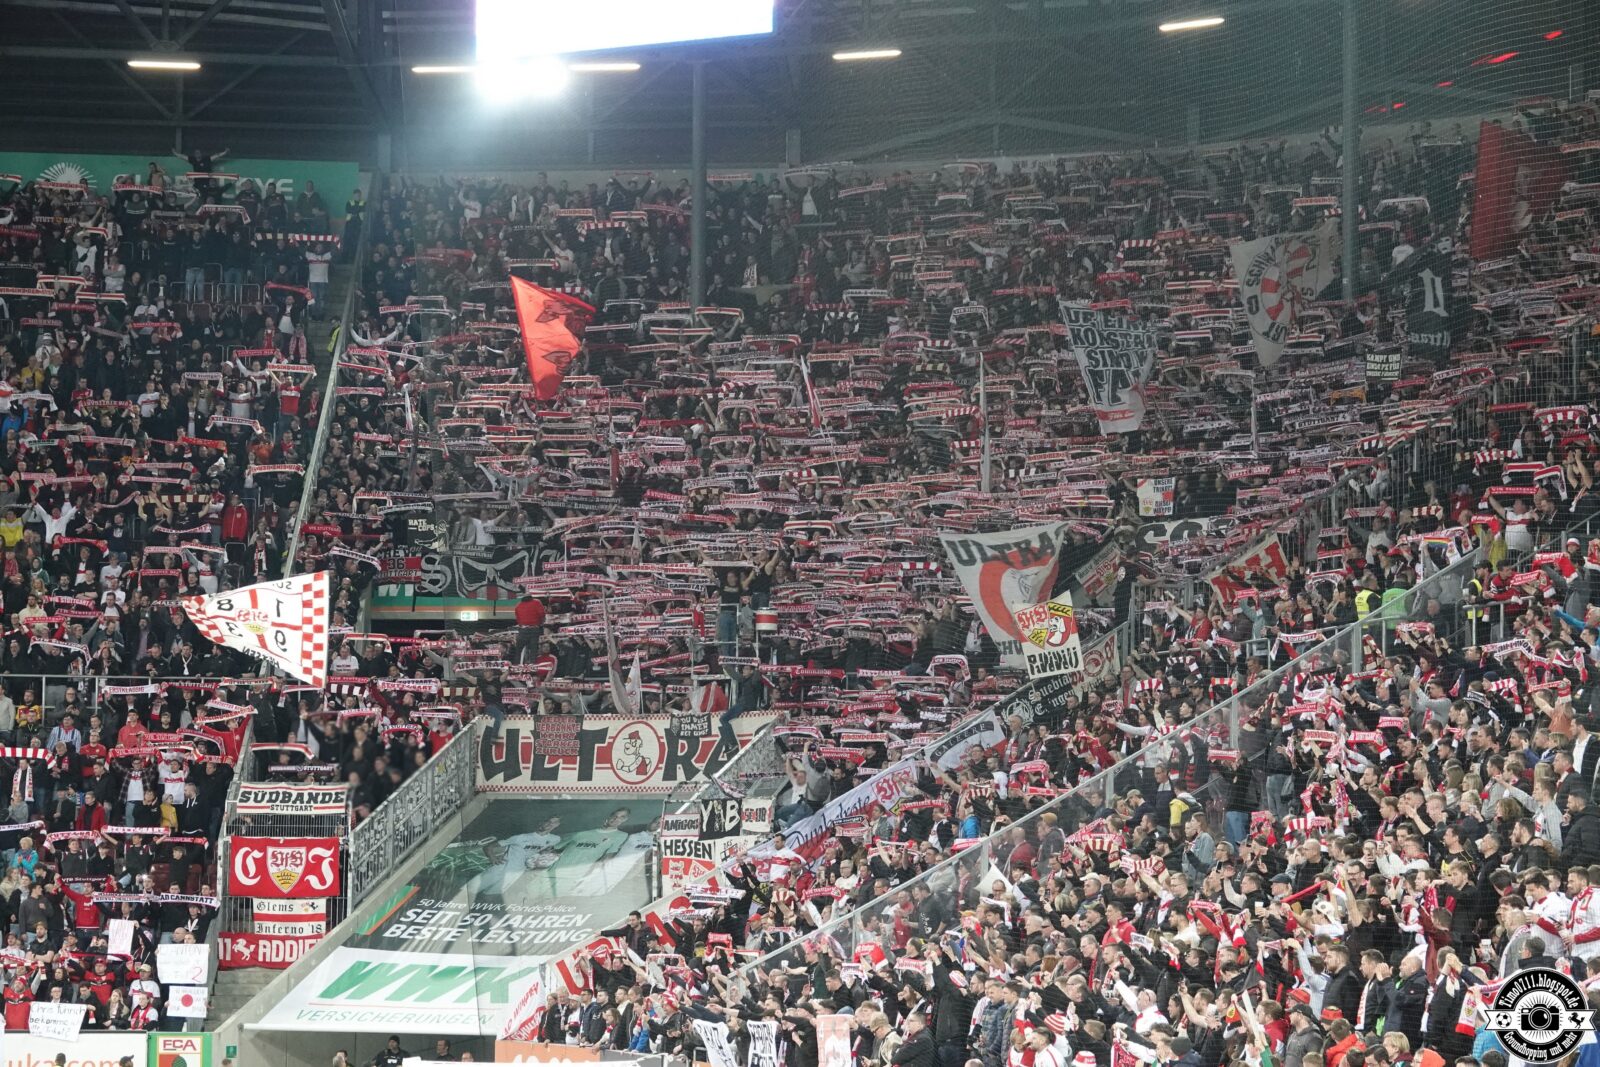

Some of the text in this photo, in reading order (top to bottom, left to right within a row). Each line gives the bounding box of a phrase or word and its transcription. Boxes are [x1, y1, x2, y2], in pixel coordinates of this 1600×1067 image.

[387, 560, 405, 570] 36
[1017, 604, 1048, 631] VfB
[108, 685, 145, 695] ERSTKLASSIG
[481, 722, 772, 783] ULTRA
[238, 790, 345, 804] SÜDBANDE
[270, 804, 313, 812] STUTTGART
[663, 839, 713, 860] HESSEN
[235, 846, 264, 886] C
[270, 850, 303, 868] VfB
[170, 894, 214, 904] CANNSTATT
[256, 901, 294, 912] Glems
[416, 898, 577, 914] 50 Jahre WWK FondsPolice
[400, 908, 592, 930] SEIT 50 JAHREN
[255, 924, 304, 934] Inferno
[382, 924, 592, 944] BESTE LEISTUNG
[192, 966, 203, 983] 2
[318, 958, 539, 1004] WWK
[296, 1008, 495, 1027] VERSICHERUNGEN
